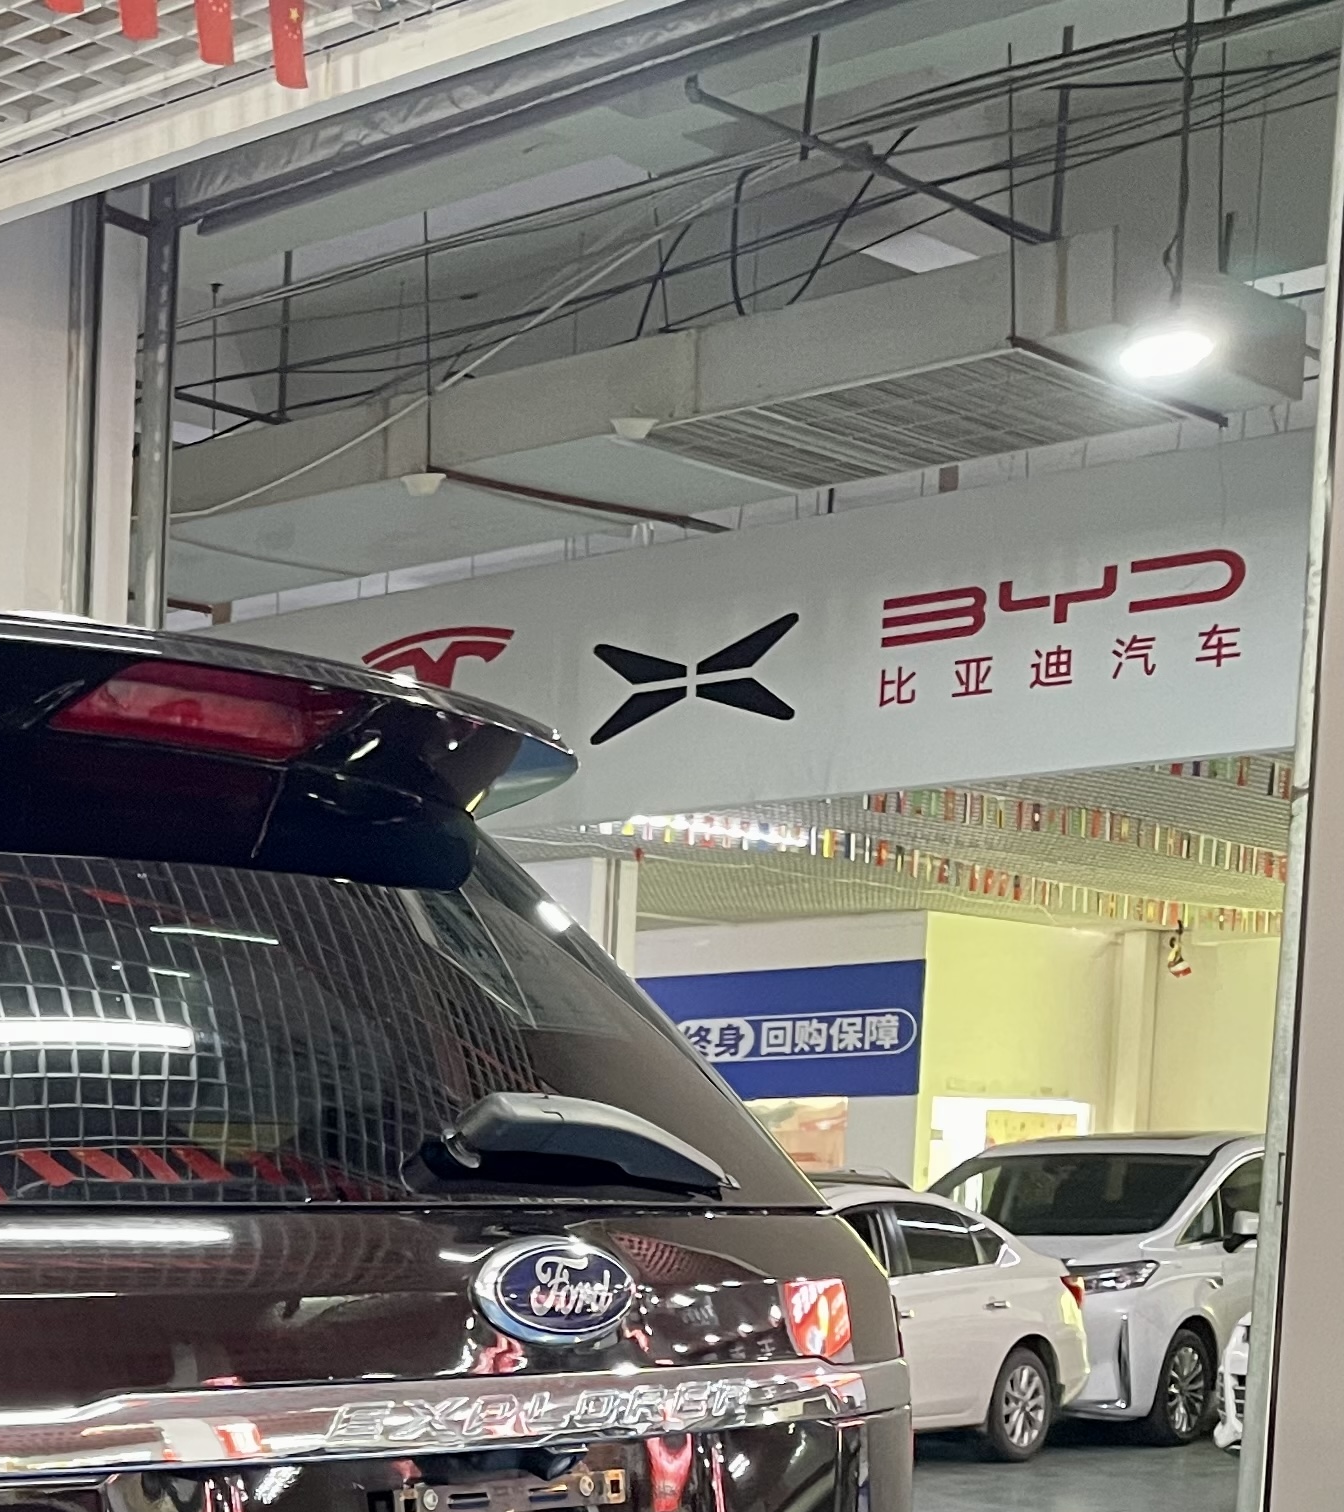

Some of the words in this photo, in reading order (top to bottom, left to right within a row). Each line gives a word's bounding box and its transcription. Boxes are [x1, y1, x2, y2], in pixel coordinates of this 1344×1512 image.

[880, 548, 1247, 648] BYD
[878, 623, 1242, 708] 比亚迪汽车
[529, 1255, 613, 1317] Ford
[325, 1377, 750, 1443] EXPLORER
